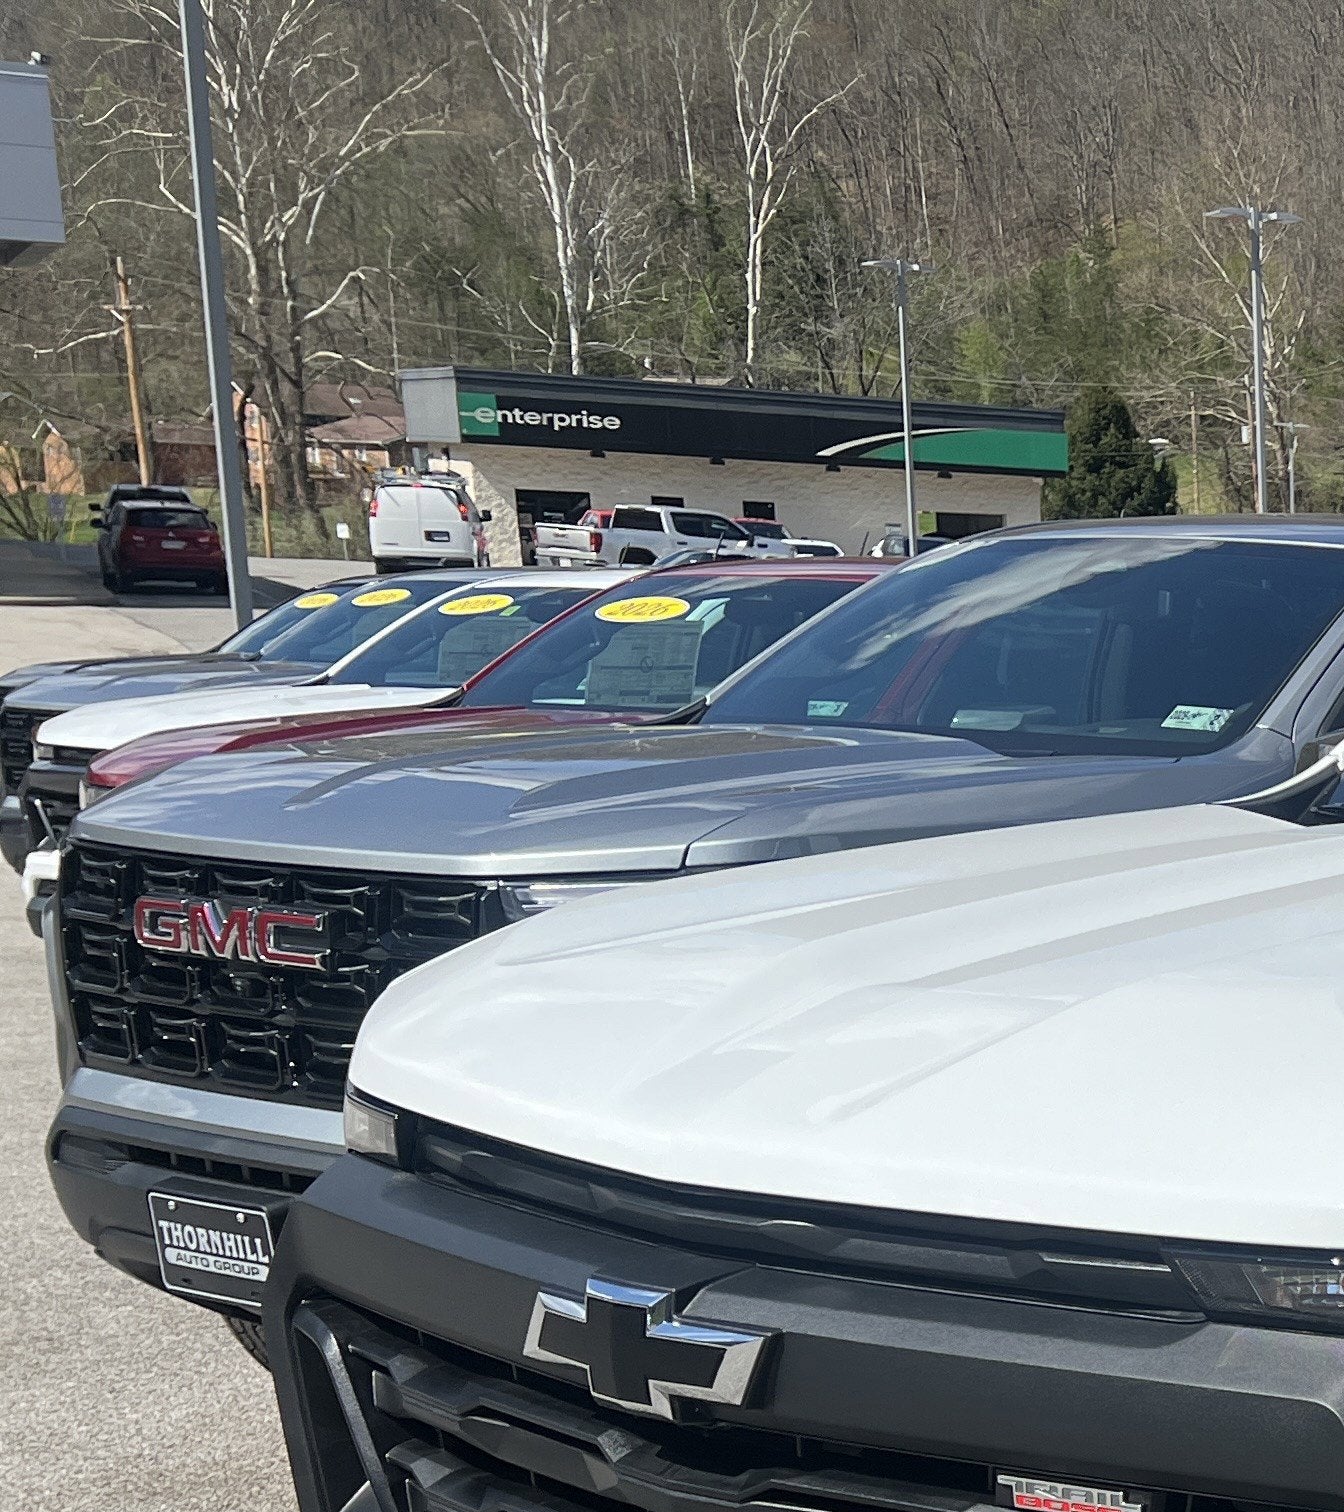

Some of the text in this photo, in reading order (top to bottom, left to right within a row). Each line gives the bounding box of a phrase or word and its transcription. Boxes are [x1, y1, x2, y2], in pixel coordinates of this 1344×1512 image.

[472, 407, 621, 431] enterprise
[605, 602, 679, 616] 2026
[134, 896, 331, 971] GMC
[158, 1220, 270, 1263] THORNHILL
[175, 1252, 260, 1276] AUTO GROUP
